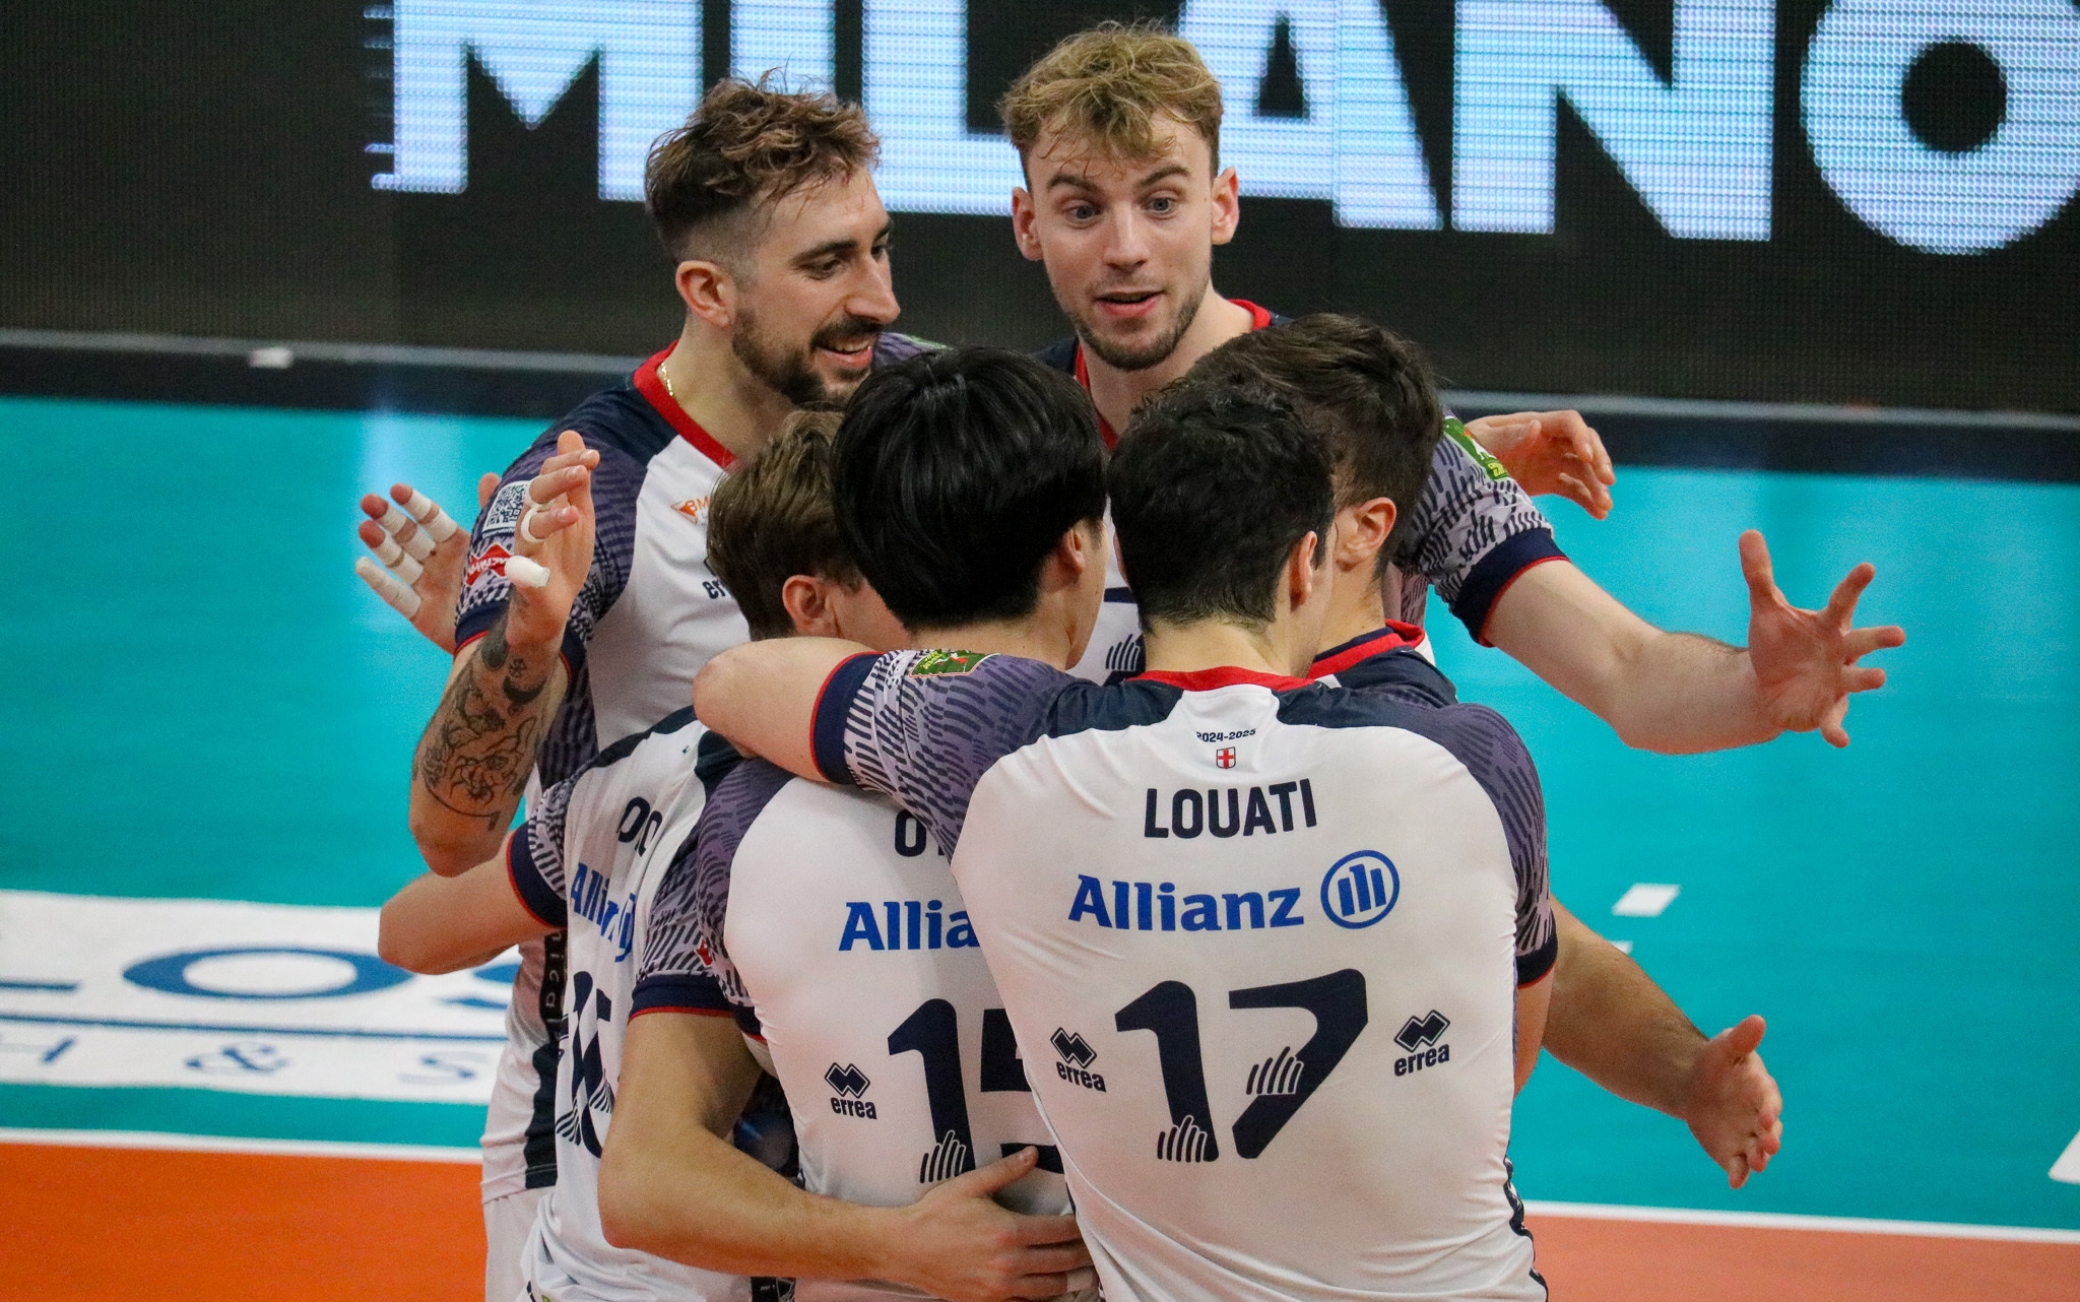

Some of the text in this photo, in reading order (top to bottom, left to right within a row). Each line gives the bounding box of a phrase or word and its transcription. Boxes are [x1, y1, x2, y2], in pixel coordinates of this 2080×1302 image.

[372, 0, 2080, 254] MLANO
[1195, 728, 1257, 743] 2024-2025
[1144, 778, 1317, 839] LOUATI
[894, 810, 945, 857] O
[1068, 874, 1304, 931] Allianz
[1055, 1061, 1107, 1093] errea
[1114, 968, 1369, 1162] 17
[1393, 1043, 1450, 1077] errea
[831, 1097, 878, 1120] errea
